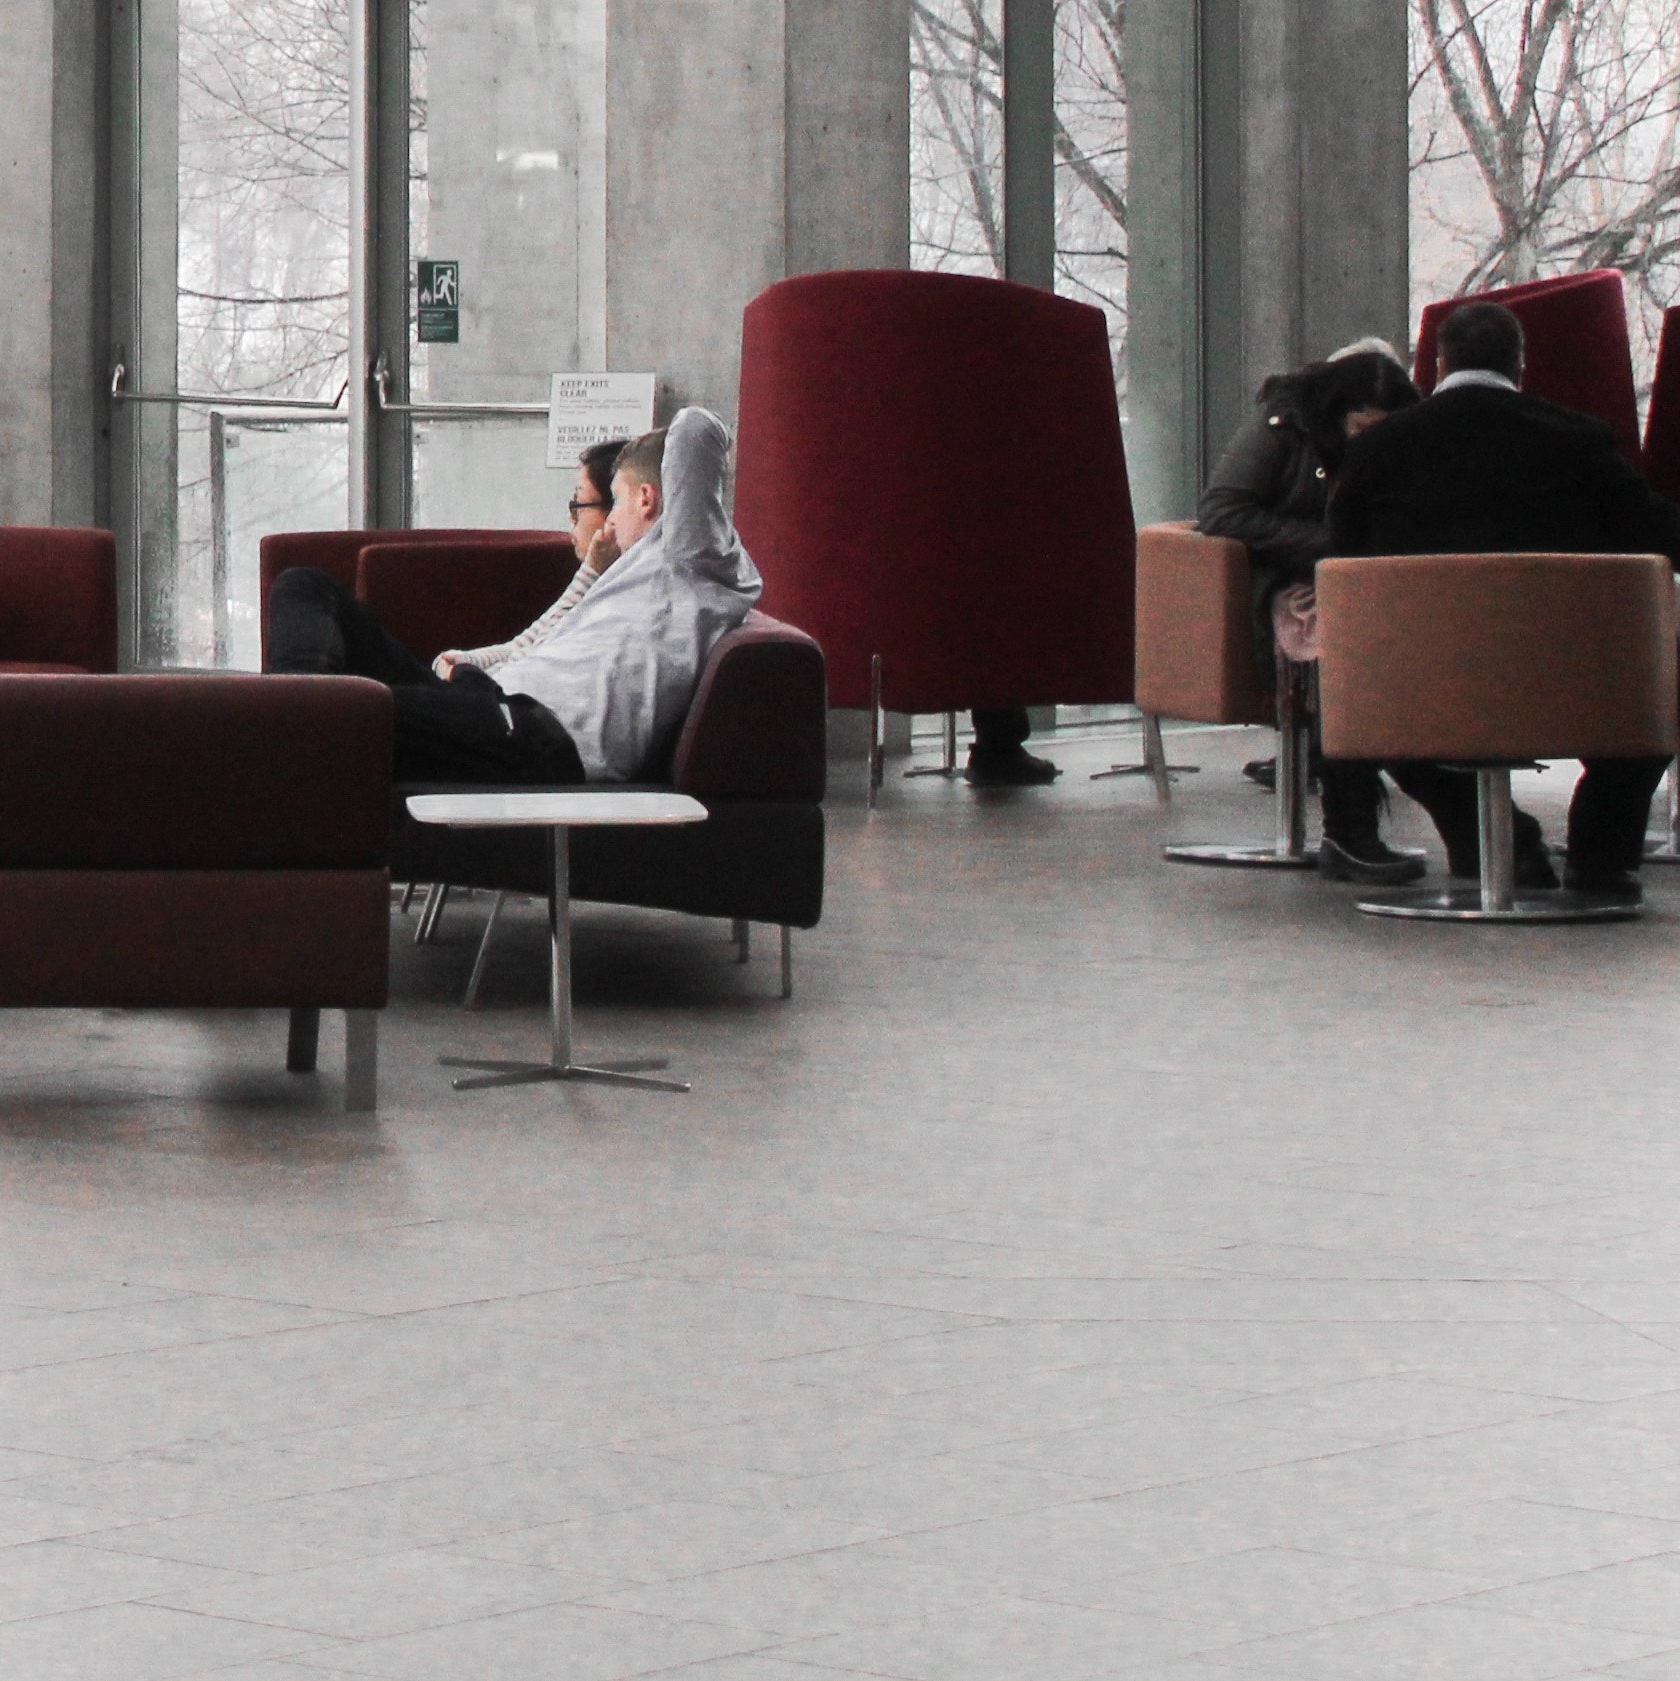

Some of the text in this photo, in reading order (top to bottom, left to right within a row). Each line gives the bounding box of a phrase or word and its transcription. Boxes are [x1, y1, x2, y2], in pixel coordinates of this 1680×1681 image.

[560, 380, 609, 388] KEEP EXITS
[559, 389, 587, 397] CLEAR
[612, 426, 630, 434] PAS
